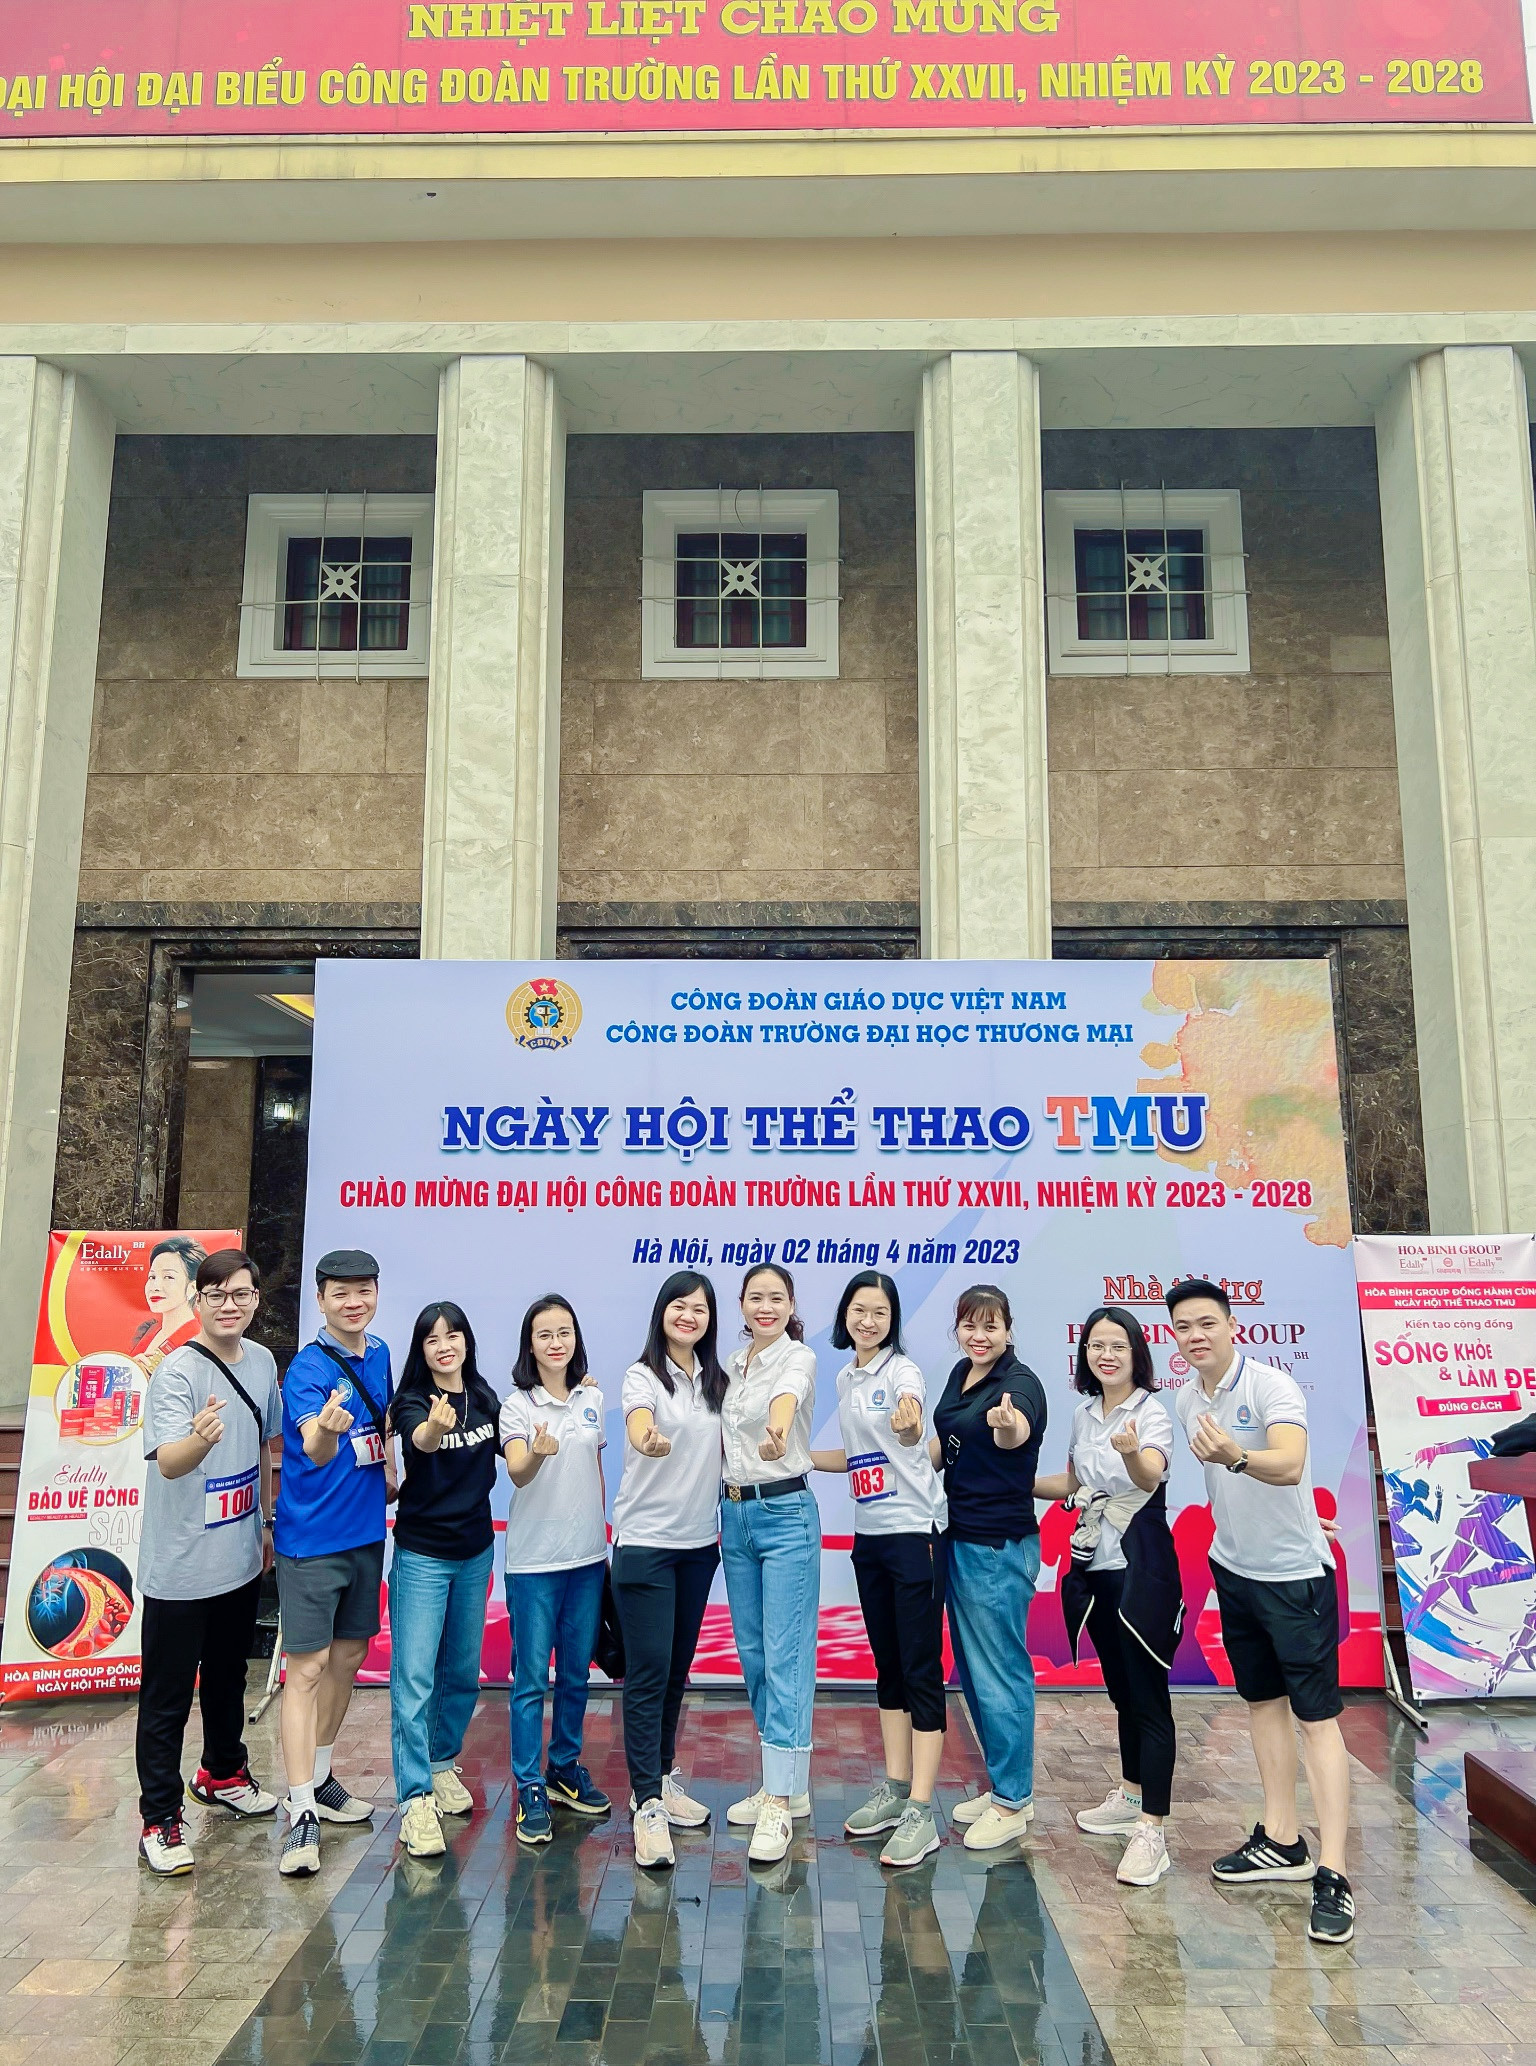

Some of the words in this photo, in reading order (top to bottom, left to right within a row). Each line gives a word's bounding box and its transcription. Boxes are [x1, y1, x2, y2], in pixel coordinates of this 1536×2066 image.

[0, 75, 47, 117] ẠI
[59, 66, 125, 115] HỘI
[136, 71, 203, 114] ĐẠI
[216, 56, 307, 105] BIỂU
[318, 62, 428, 105] CÔNG
[440, 60, 550, 102] ĐOÀN
[562, 57, 720, 101] TRƯỜNG
[732, 53, 811, 100] LẦN
[822, 57, 902, 99] THỨ
[910, 63, 1027, 102] XXVII,
[1040, 54, 1172, 104] NHIỆM
[1185, 53, 1236, 95] KỲ
[1249, 59, 1346, 94] 2023
[1386, 59, 1485, 94] 2028
[670, 988, 742, 1010] CÔNG
[747, 988, 818, 1010] ĐOÀN
[823, 988, 886, 1010] GIÁO
[892, 991, 944, 1015] DỤC
[949, 987, 1005, 1015] VIỆT
[1011, 991, 1067, 1010] NAM
[605, 1020, 678, 1043] CÔNG
[683, 1020, 754, 1043] ĐOÀN
[759, 1020, 861, 1043] TRƯỜNG
[866, 1024, 910, 1048] ĐẠI
[916, 1024, 970, 1048] HỌC
[975, 1023, 1080, 1043] THƯƠNG
[1086, 1024, 1134, 1048] MẠI
[442, 1095, 610, 1147] NGÀY
[625, 1095, 729, 1158] HỘI
[745, 1086, 856, 1147] THỂ
[872, 1105, 1030, 1148] THAO
[1045, 1095, 1206, 1149] TMU
[339, 1175, 407, 1208] CHÀO
[414, 1175, 490, 1208] MỪNG
[496, 1180, 539, 1213] ĐẠI
[546, 1175, 587, 1213] HỘI
[595, 1175, 662, 1208] CÔNG
[669, 1175, 738, 1208] ĐOÀN
[744, 1174, 841, 1208] TRƯỜNG
[848, 1171, 896, 1208] LẦN
[902, 1175, 952, 1208] THỨ
[957, 1181, 1030, 1211] XXVII,
[1037, 1175, 1119, 1214] NHIỆM
[1126, 1175, 1158, 1208] KỲ
[1166, 1181, 1227, 1208] 2023
[1251, 1181, 1313, 1208] 2028
[81, 1241, 132, 1265] Edally
[632, 1238, 662, 1264] Hà
[668, 1238, 713, 1269] Nội,
[720, 1238, 776, 1266] ngày
[782, 1238, 811, 1264] 02
[816, 1238, 880, 1267] tháng
[886, 1238, 901, 1264] 4
[906, 1238, 959, 1264] năm
[962, 1238, 1021, 1265] 2023
[1397, 1245, 1425, 1255] HOA
[1427, 1245, 1457, 1255] BINH
[1459, 1244, 1501, 1255] GROUP
[1102, 1274, 1166, 1300] Nhà
[1364, 1287, 1387, 1297] HÒA
[1389, 1286, 1413, 1297] BÌNH
[1415, 1288, 1450, 1297] GROUP
[1483, 1286, 1513, 1296] HÀNH
[1514, 1286, 1536, 1296] CÙN
[1394, 1298, 1422, 1307] NGÀY
[1423, 1298, 1442, 1309] HỘI
[1464, 1298, 1492, 1307] THAO
[1493, 1298, 1516, 1307] TMU
[1230, 1323, 1306, 1345] ROUP
[1405, 1319, 1430, 1329] Kiến
[1432, 1321, 1451, 1331] tạo
[1453, 1319, 1482, 1331] cộng
[1374, 1331, 1449, 1366] SỐNG
[1453, 1338, 1493, 1362] KHỎE
[1438, 1366, 1452, 1381] &
[1457, 1364, 1498, 1388] LÀM
[1438, 1401, 1469, 1412] ĐÚNG
[1470, 1399, 1503, 1411] CÁCH
[53, 1464, 108, 1488] Edally
[852, 1466, 884, 1498] 083
[28, 1485, 63, 1511] BẢO
[67, 1486, 89, 1512] VỆ
[93, 1485, 140, 1508] DÒNG
[218, 1484, 254, 1519] 100
[4, 1669, 30, 1682] HÒA
[32, 1668, 61, 1681] BÌNH
[63, 1666, 105, 1679] GROUP
[36, 1681, 69, 1693] NGÀY
[70, 1679, 92, 1691] HỘI
[119, 1677, 141, 1687] THA
